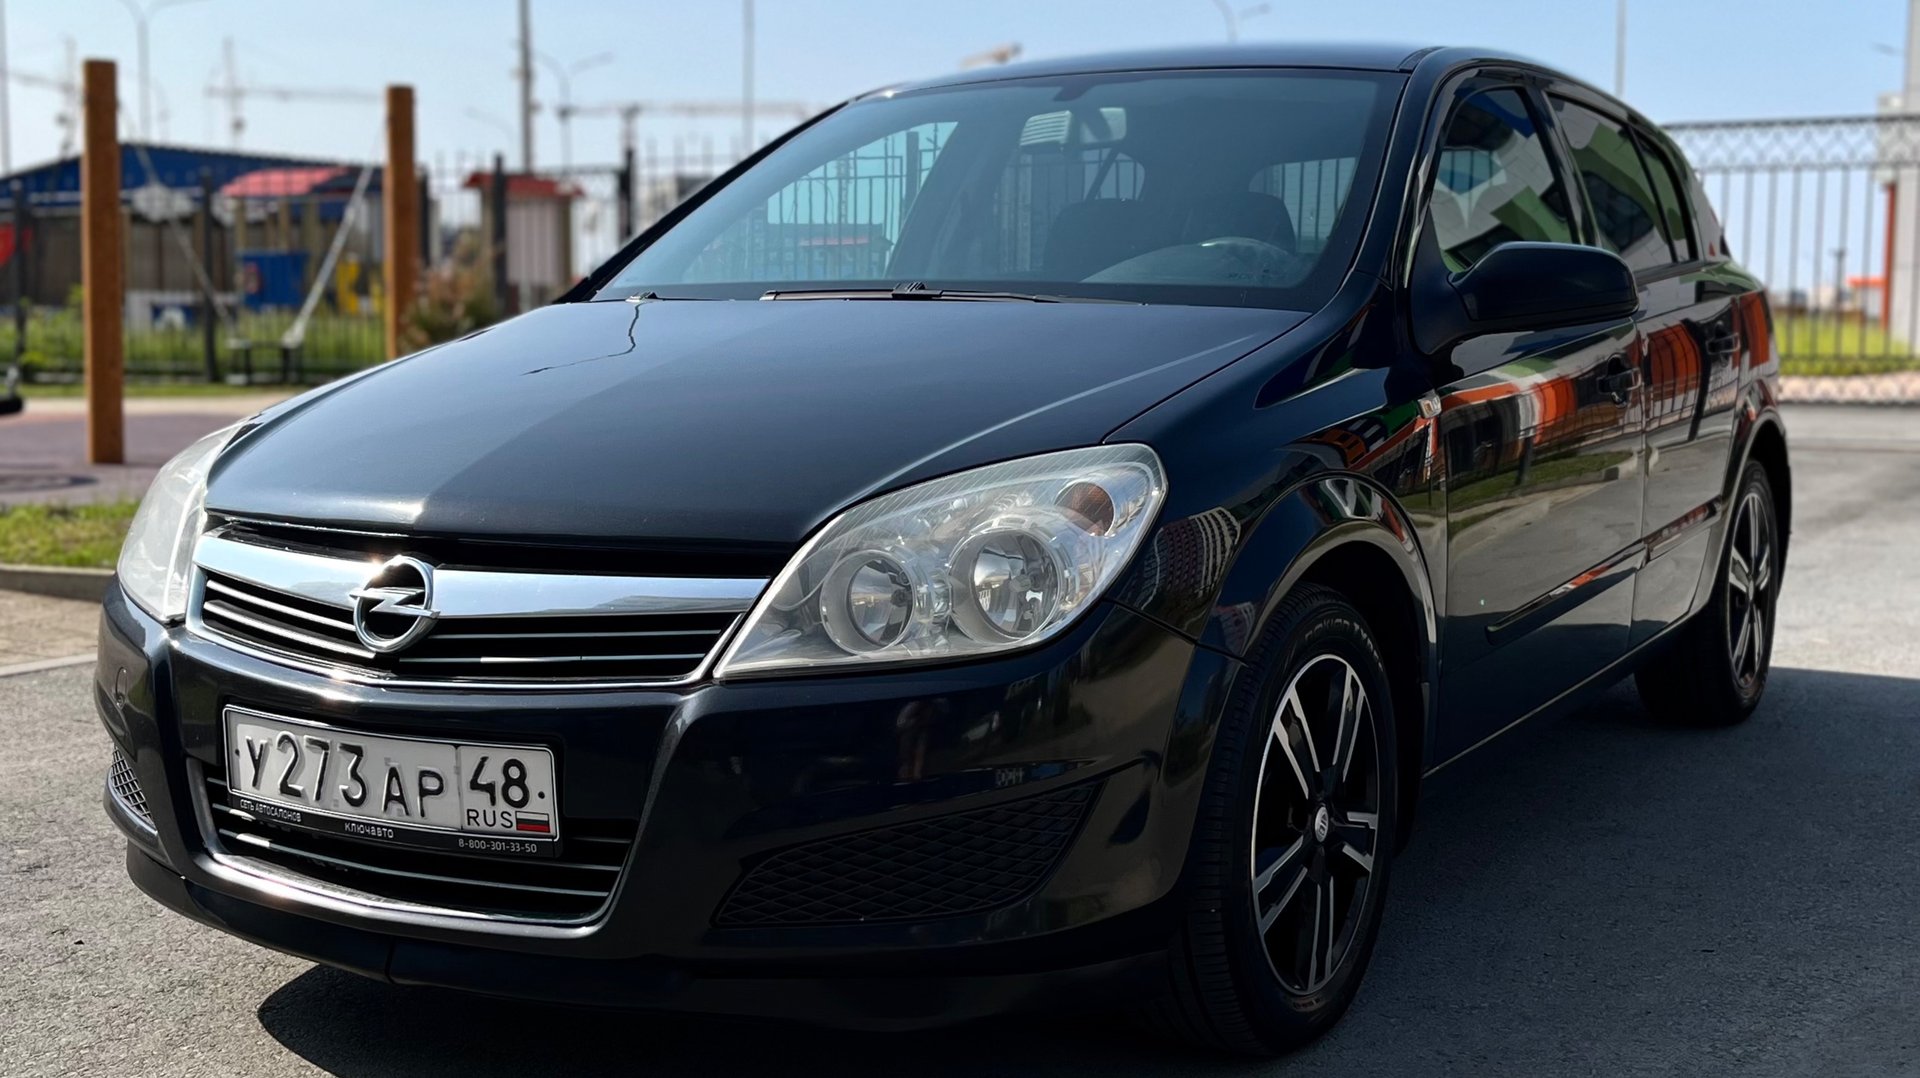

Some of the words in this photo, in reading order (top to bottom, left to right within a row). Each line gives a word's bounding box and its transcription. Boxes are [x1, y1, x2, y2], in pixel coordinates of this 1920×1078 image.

[469, 755, 530, 809] 48
[240, 798, 255, 811] СЕТЬ
[255, 802, 302, 823] АВТОСАЛОНОВ
[466, 808, 514, 829] RUS
[458, 838, 538, 854] 8-800-301-33-50
